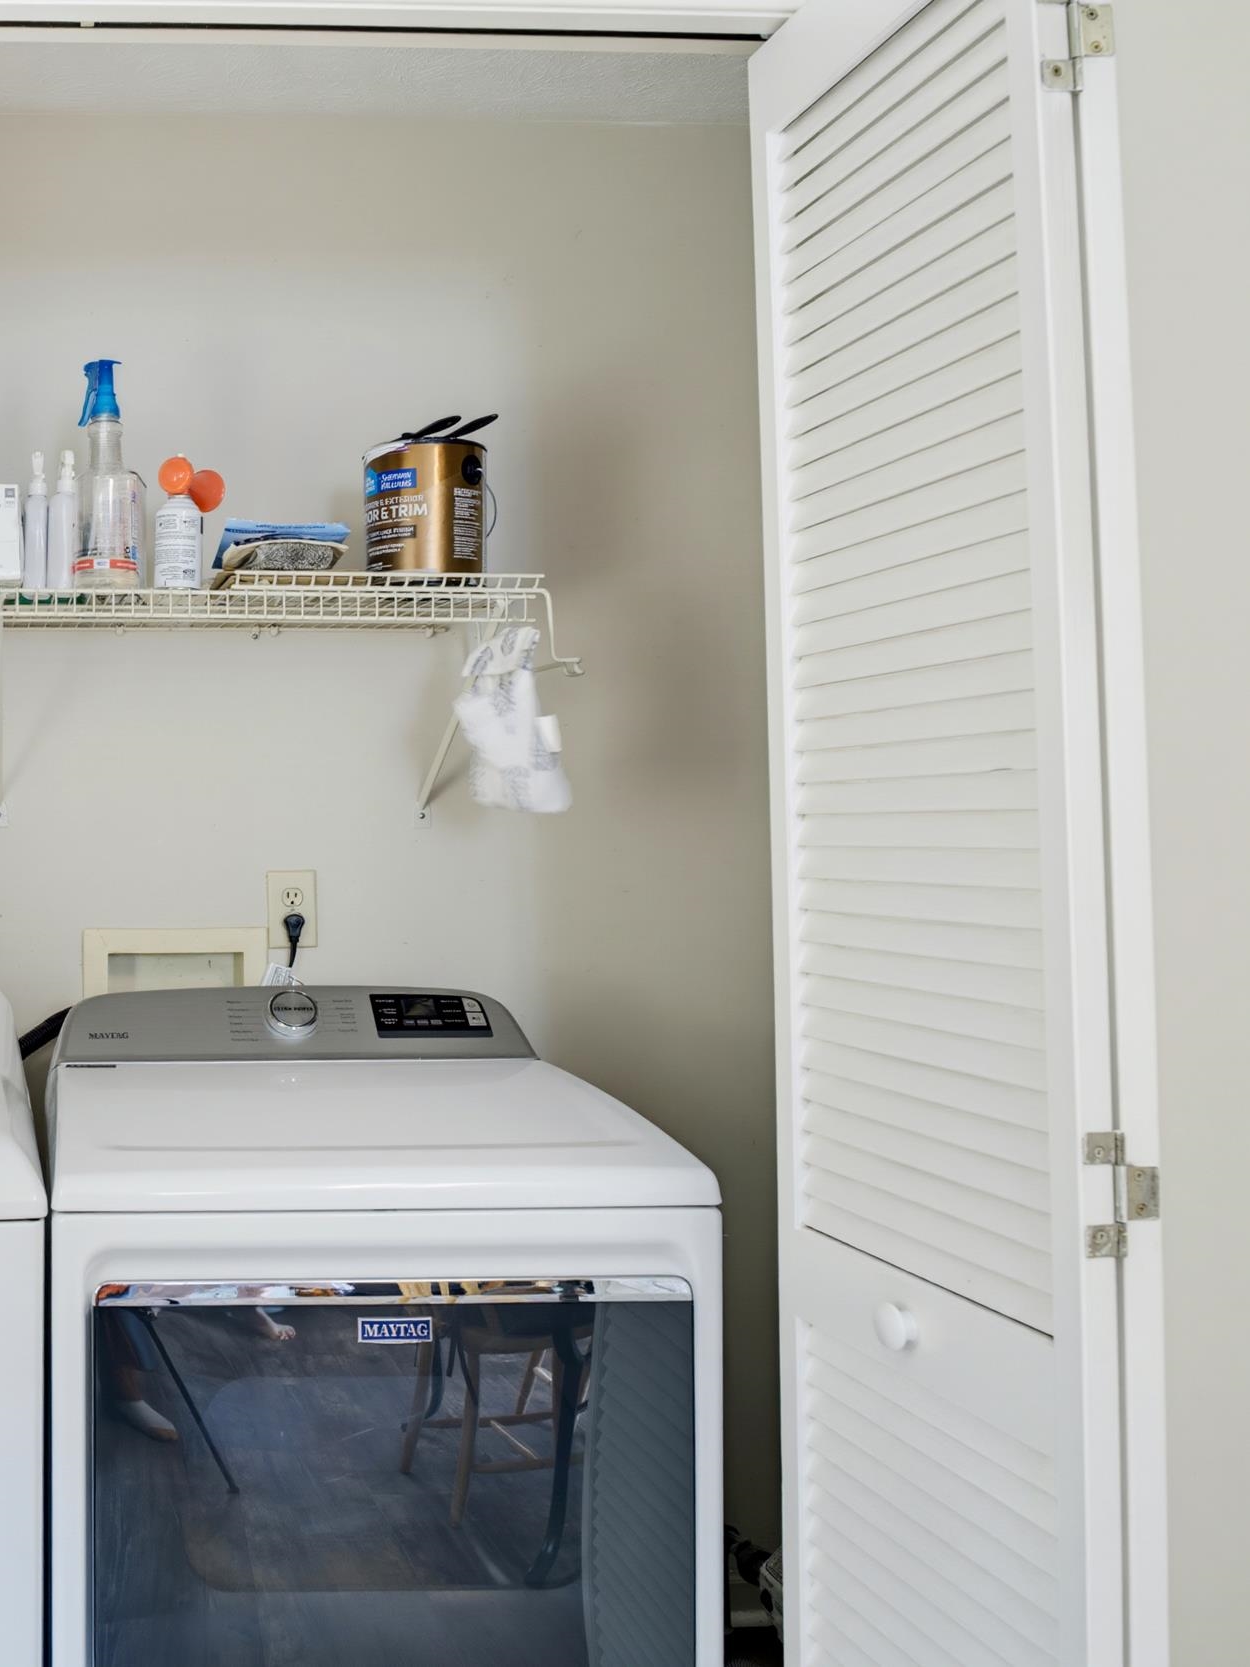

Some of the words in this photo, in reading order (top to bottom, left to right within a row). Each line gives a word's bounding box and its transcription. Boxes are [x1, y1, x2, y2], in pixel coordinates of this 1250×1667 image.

[366, 509, 380, 523] OR
[381, 506, 389, 520] &
[389, 503, 428, 518] TRIM
[363, 1323, 429, 1337] MAYTAG
